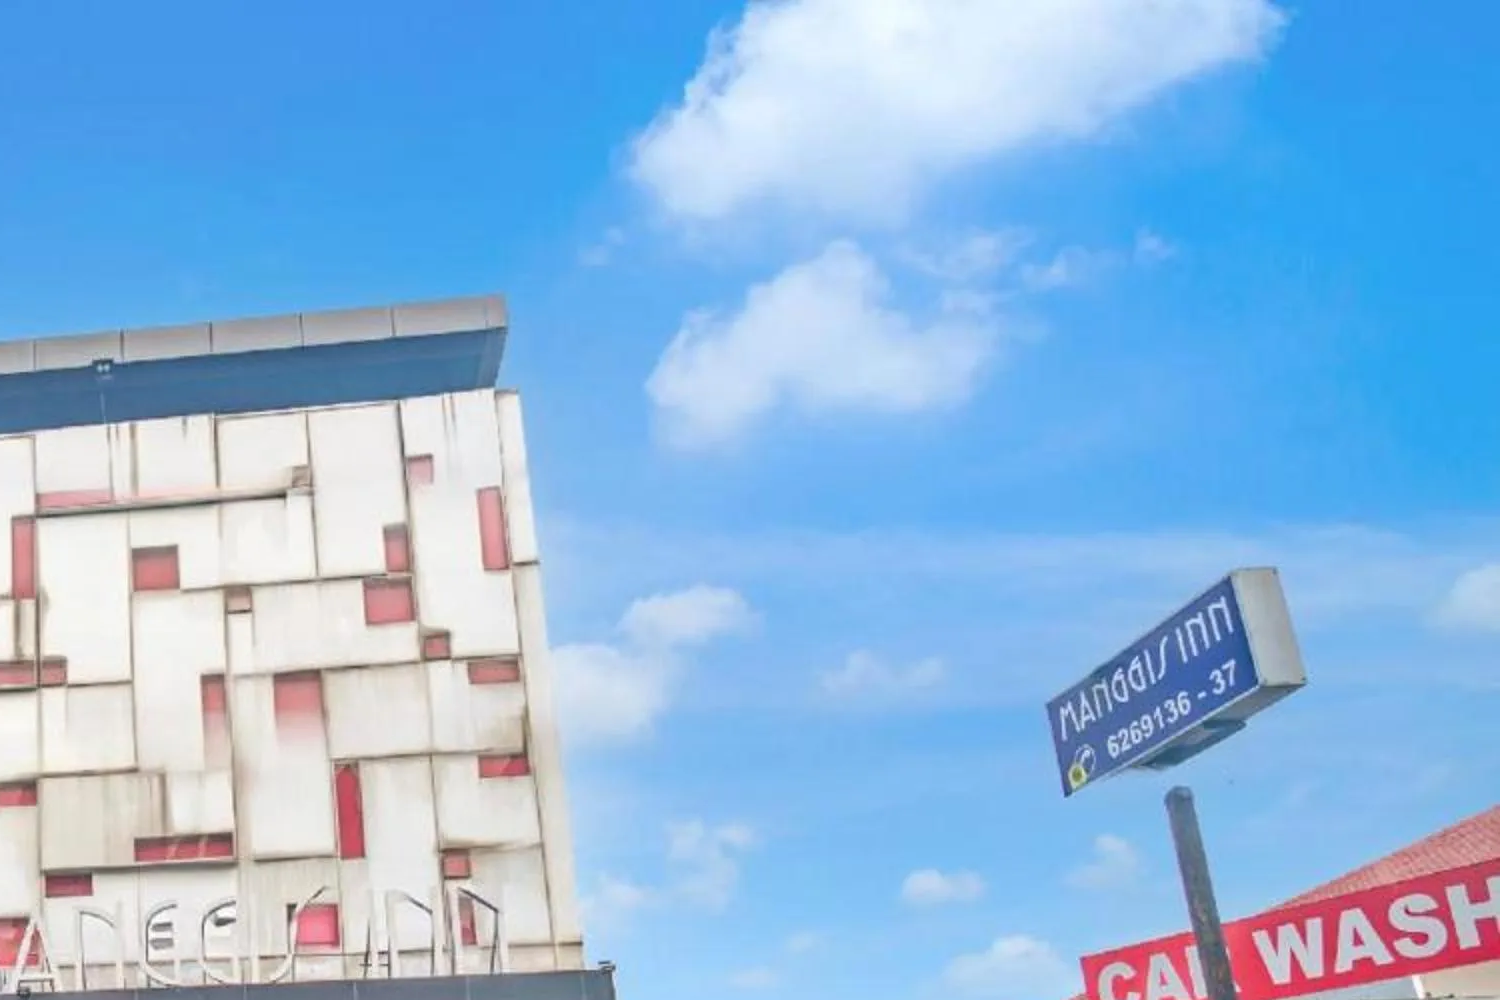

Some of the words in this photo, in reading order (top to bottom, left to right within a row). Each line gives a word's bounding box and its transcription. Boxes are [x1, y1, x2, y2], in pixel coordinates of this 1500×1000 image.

[1106, 691, 1192, 758] 6269136
[1209, 659, 1237, 695] 37
[1252, 875, 1500, 985] WASH
